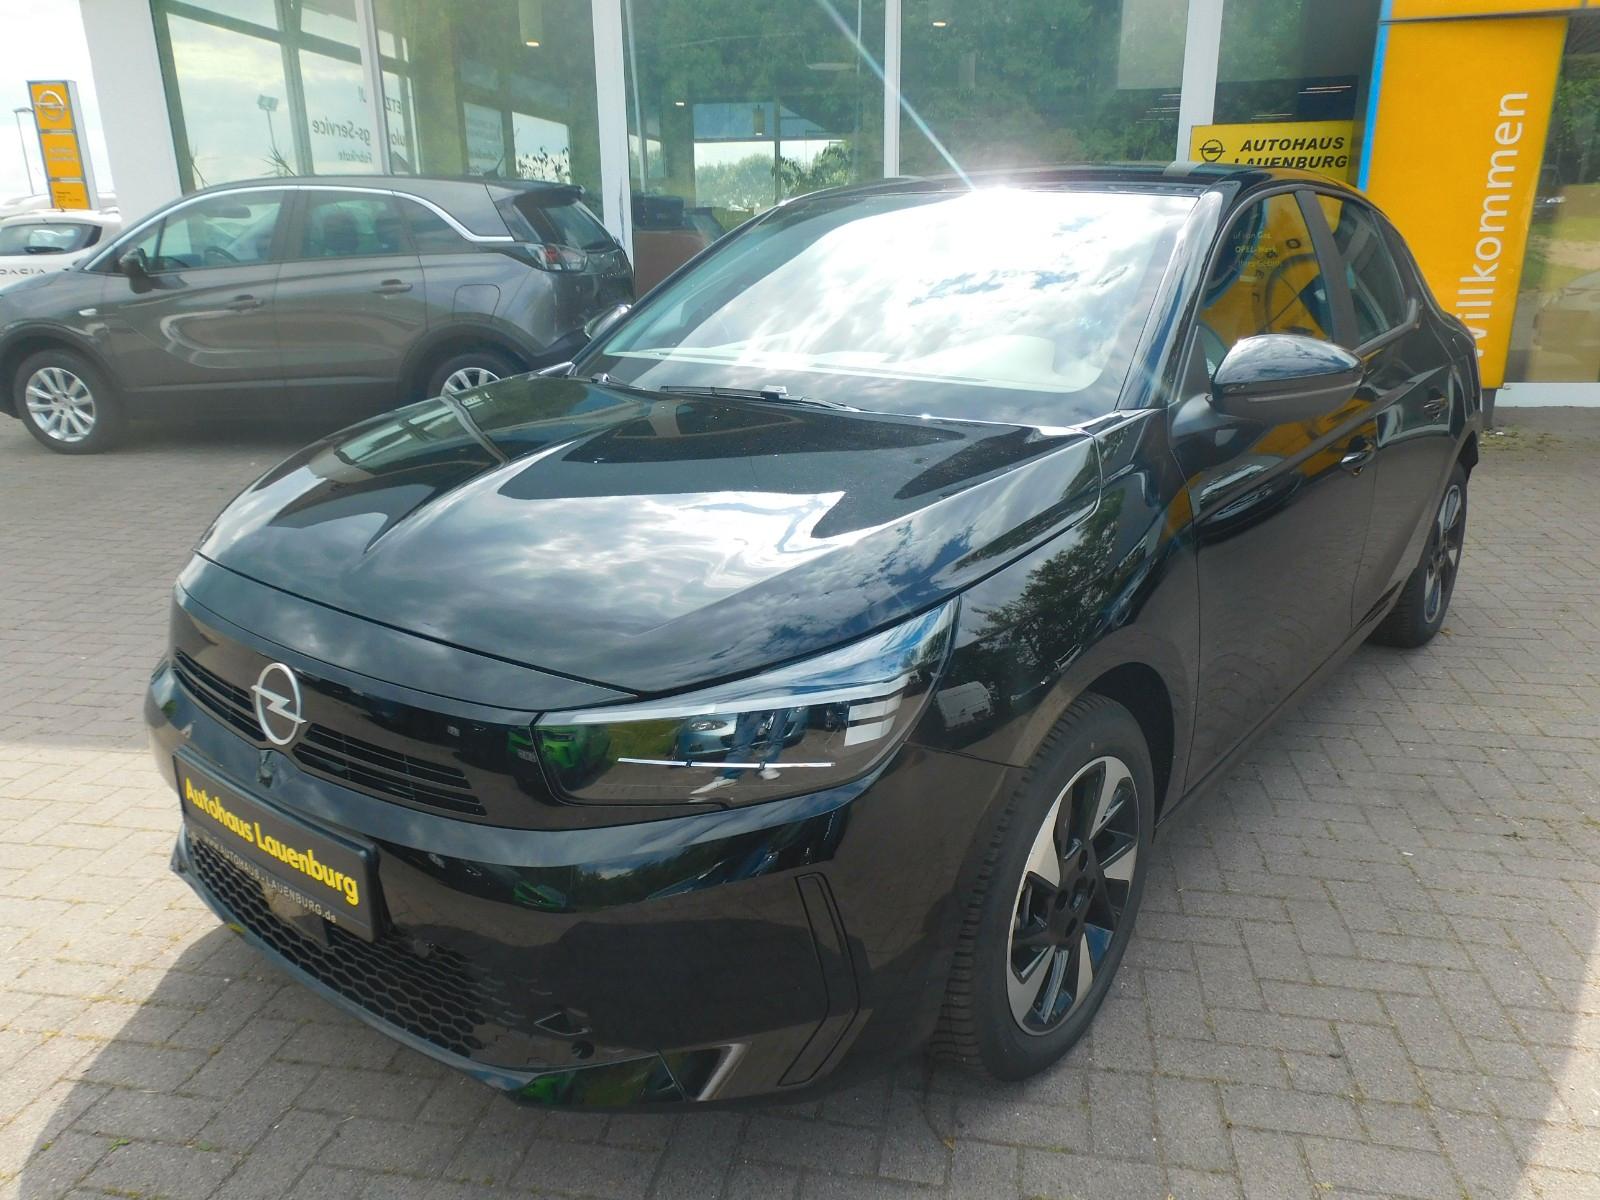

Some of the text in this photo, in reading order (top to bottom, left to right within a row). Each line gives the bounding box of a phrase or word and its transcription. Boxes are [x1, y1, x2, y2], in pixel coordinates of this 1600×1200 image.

[1240, 136, 1345, 152] AUTOHAUS
[185, 777, 360, 906] Autohaus Lauenburg
